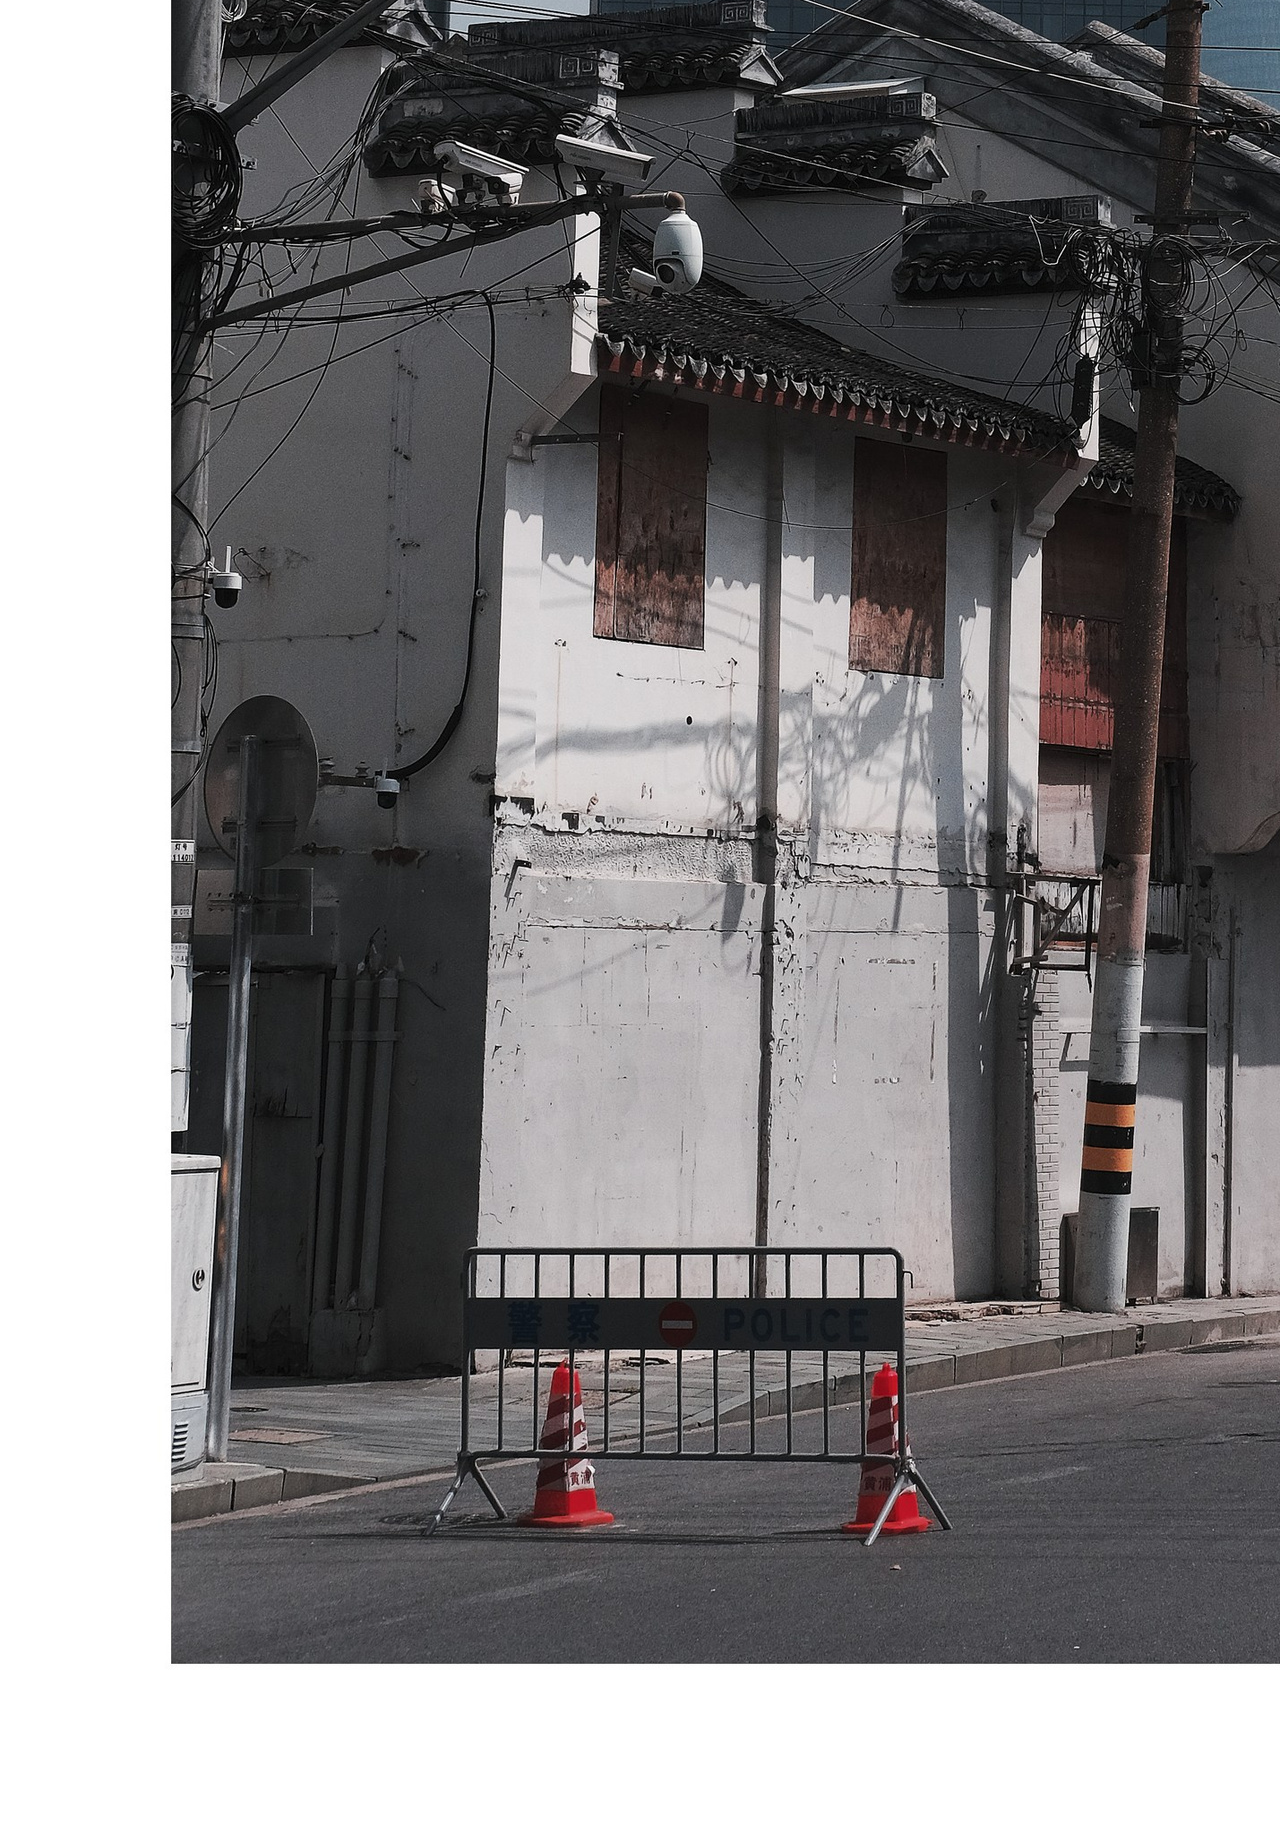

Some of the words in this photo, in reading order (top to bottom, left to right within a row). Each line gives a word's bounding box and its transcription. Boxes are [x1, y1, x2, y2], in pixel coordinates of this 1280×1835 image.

[507, 1300, 601, 1345] 警察
[723, 1306, 869, 1344] POLICE
[863, 1475, 892, 1492] 黄浦
